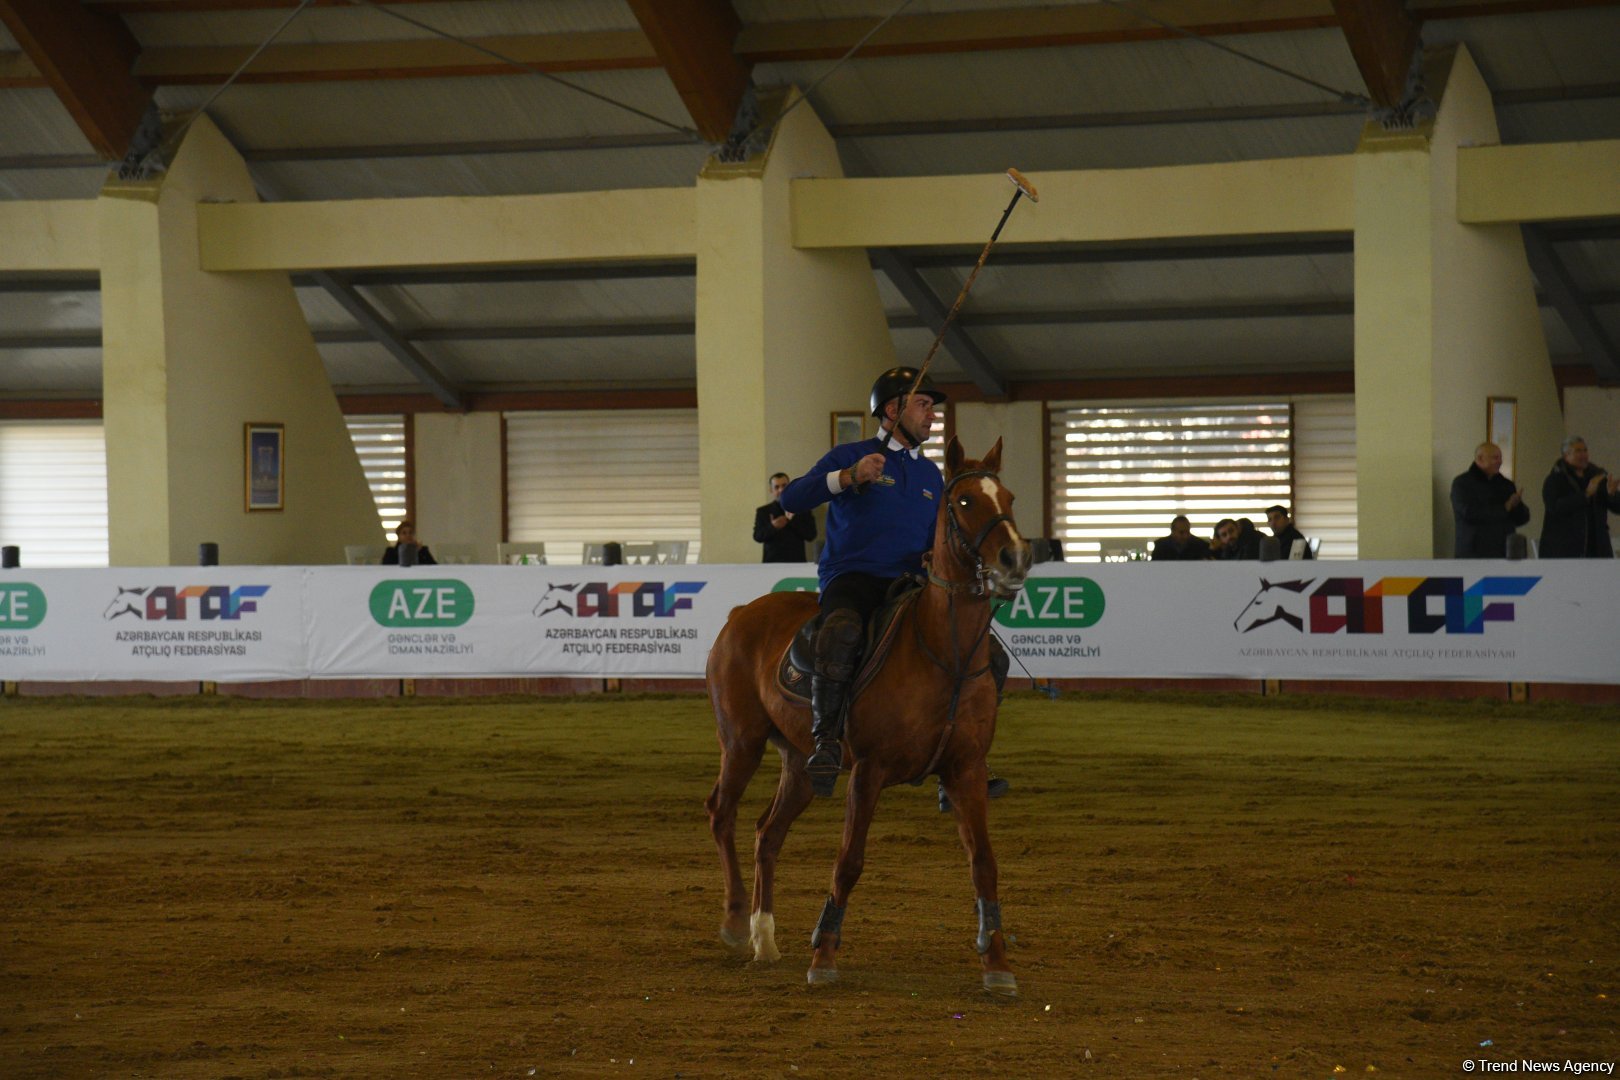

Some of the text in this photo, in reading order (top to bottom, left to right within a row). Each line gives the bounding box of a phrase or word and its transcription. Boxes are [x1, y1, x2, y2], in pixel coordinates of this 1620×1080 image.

[388, 588, 456, 619] AZE
[1010, 586, 1085, 619] AZE
[115, 628, 262, 641] AZƏRBAYCAN RESPUBLİKASI
[545, 626, 698, 639] AZƏRBAYCAN RESPUBLİKASI
[1011, 634, 1081, 644] GƏNCLƏR VƏ
[174, 643, 246, 656] FEDERASİYASI
[606, 641, 681, 653] FEDERASİYASI
[1049, 645, 1101, 657] NAZİRLİYİ
